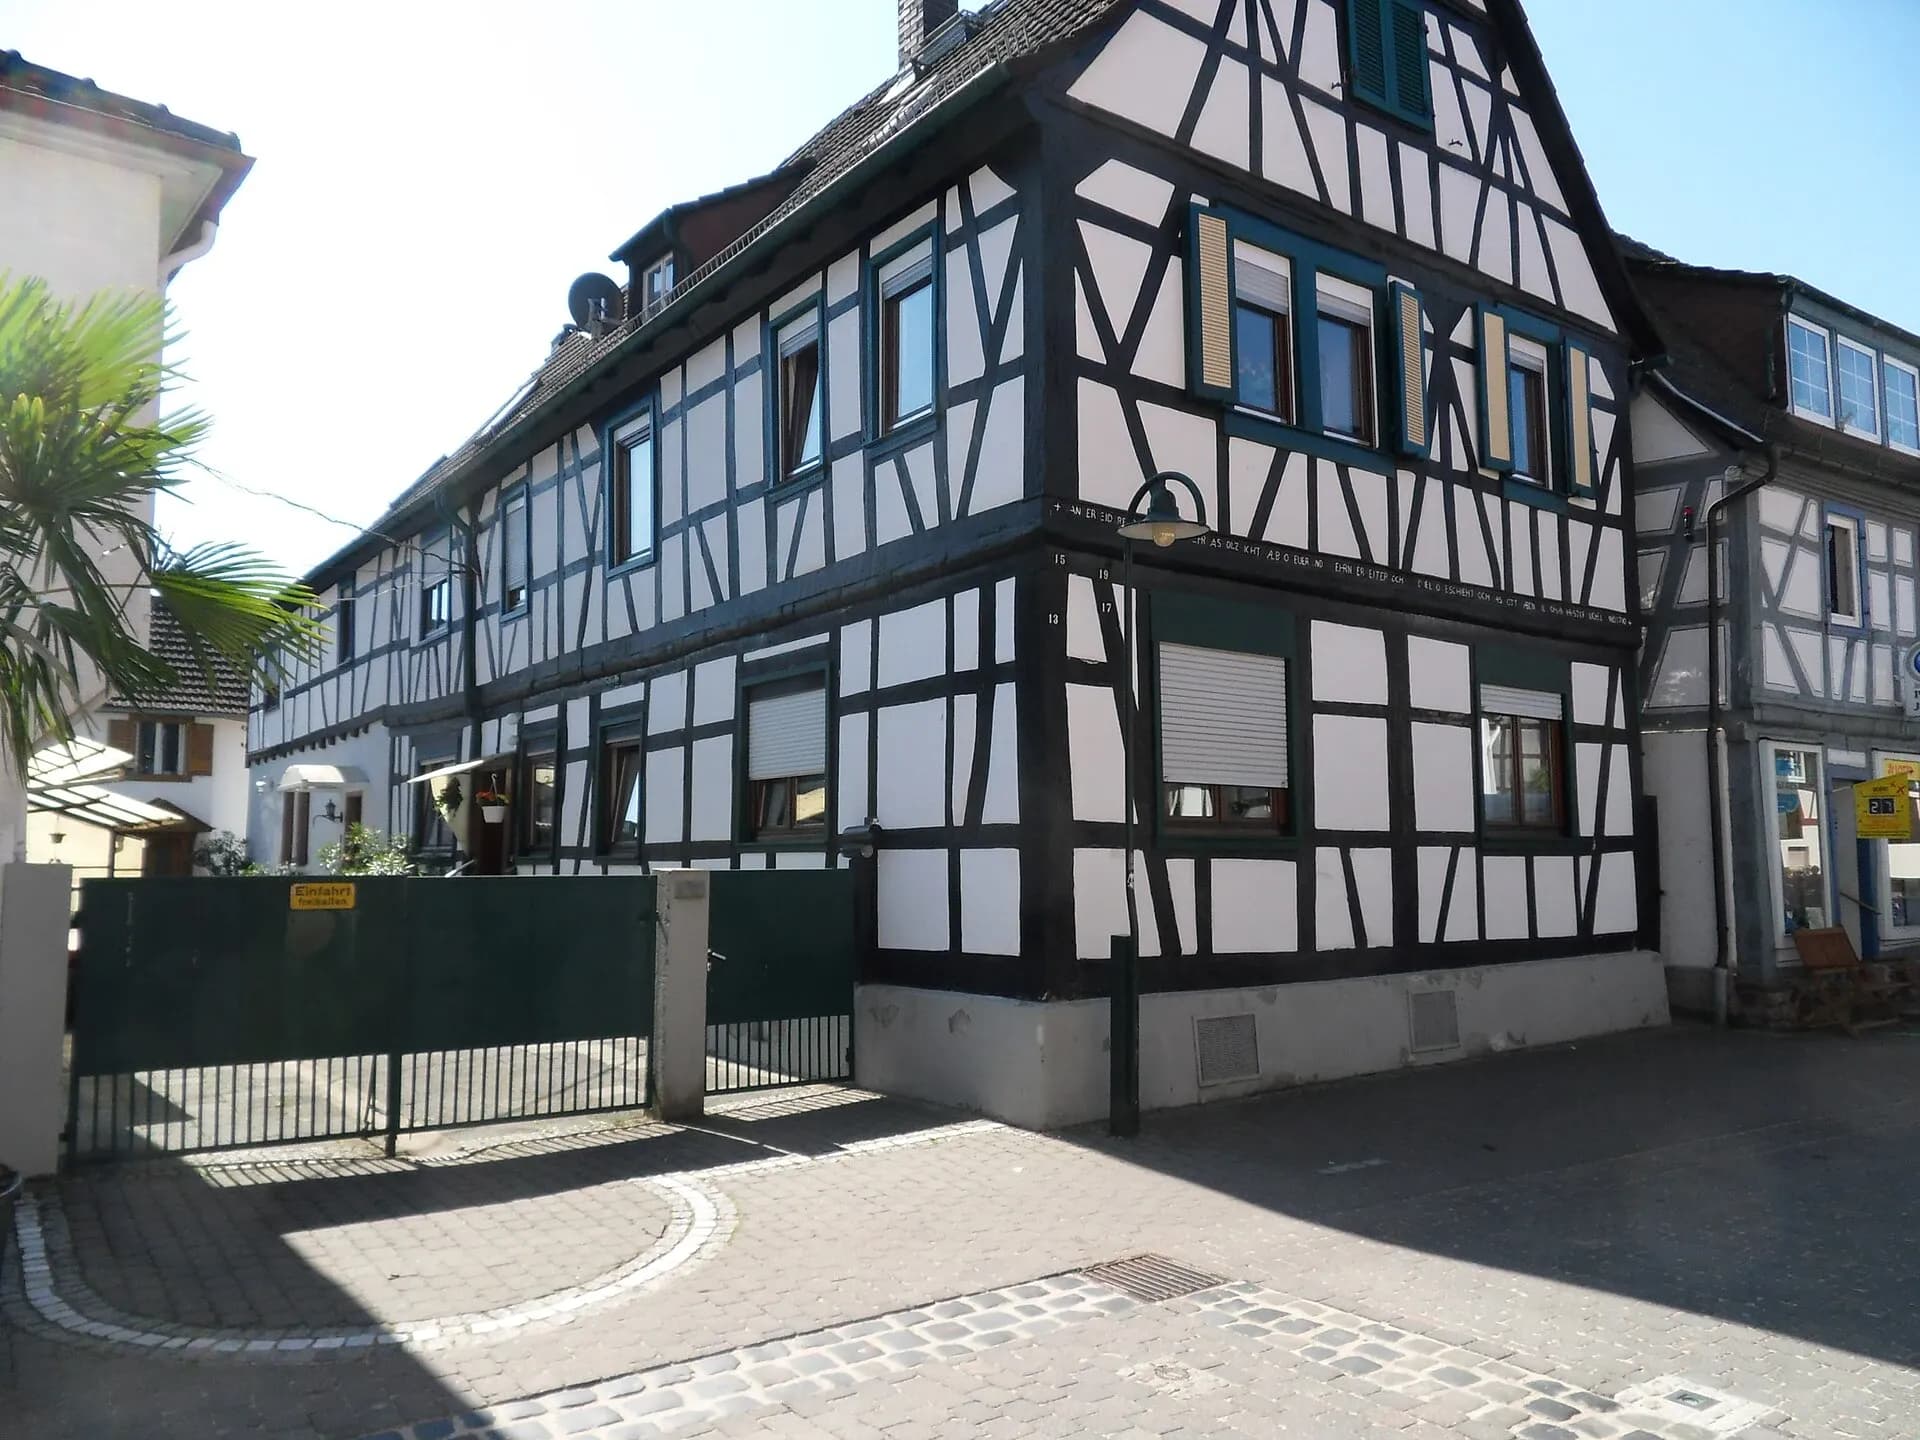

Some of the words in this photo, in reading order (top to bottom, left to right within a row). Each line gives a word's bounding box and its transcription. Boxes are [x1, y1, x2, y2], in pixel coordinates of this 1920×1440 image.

[1055, 554, 1066, 565] 15
[1099, 569, 1109, 580] 19
[1102, 602, 1112, 613] 17
[1048, 613, 1059, 624] 13
[295, 886, 351, 897] Einfahrt
